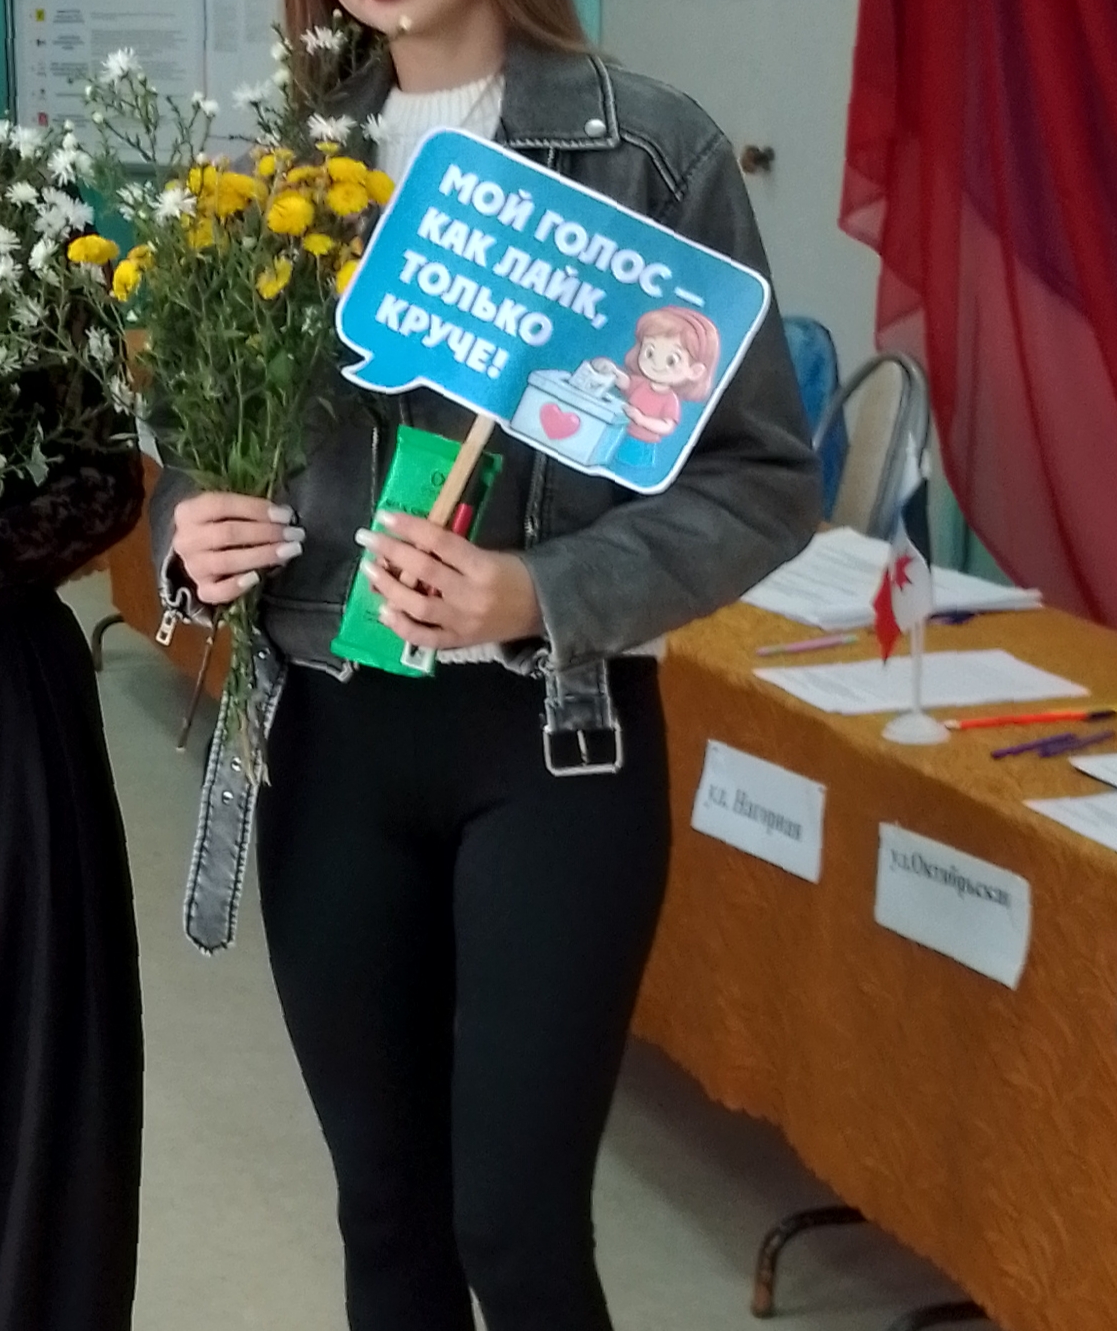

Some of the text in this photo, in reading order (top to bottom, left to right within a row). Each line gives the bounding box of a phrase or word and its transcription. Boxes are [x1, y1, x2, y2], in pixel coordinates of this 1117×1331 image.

[417, 206, 608, 330] КАК ЛАЙК,
[438, 163, 534, 232] МОЙ
[534, 209, 672, 298] ГОЛОС
[375, 292, 510, 380] КРУЧЕ!
[399, 249, 553, 346] ТОЛЬКО
